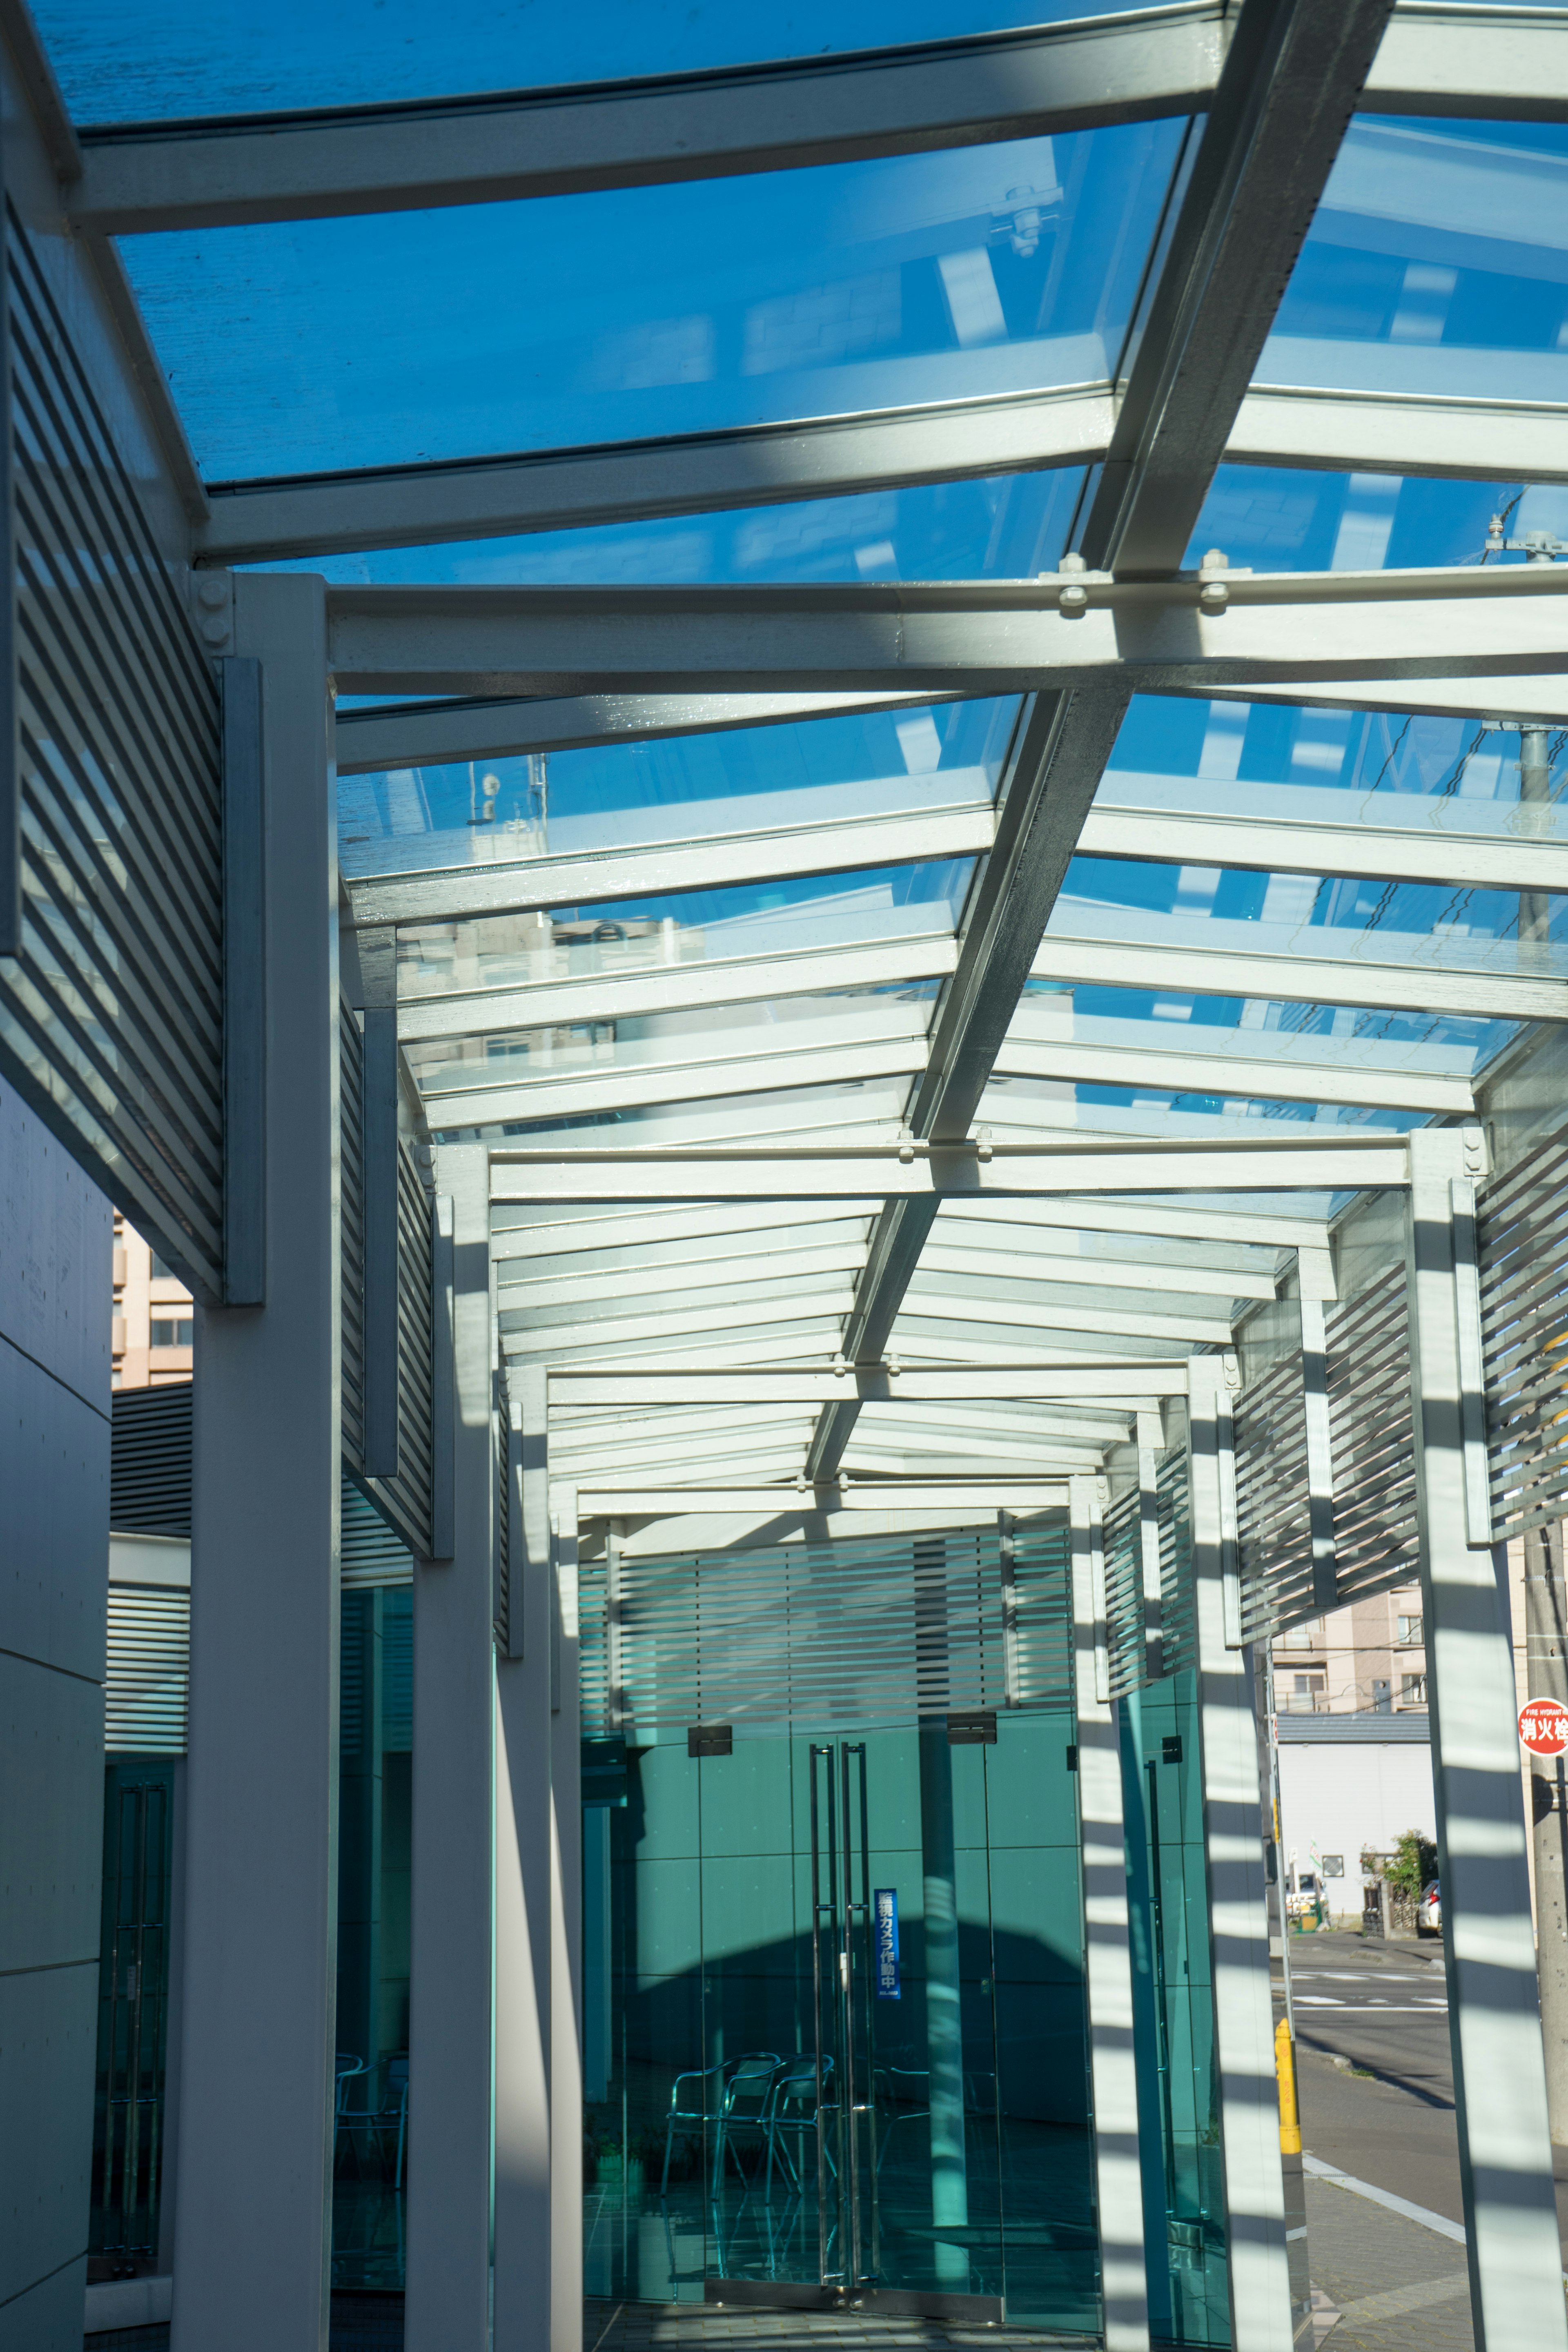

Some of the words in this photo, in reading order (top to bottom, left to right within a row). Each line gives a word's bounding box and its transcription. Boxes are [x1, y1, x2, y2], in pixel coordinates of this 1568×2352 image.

[1521, 1717, 1568, 1741] 消火栓
[878, 1892, 895, 1988] 監視カメラ作動中
